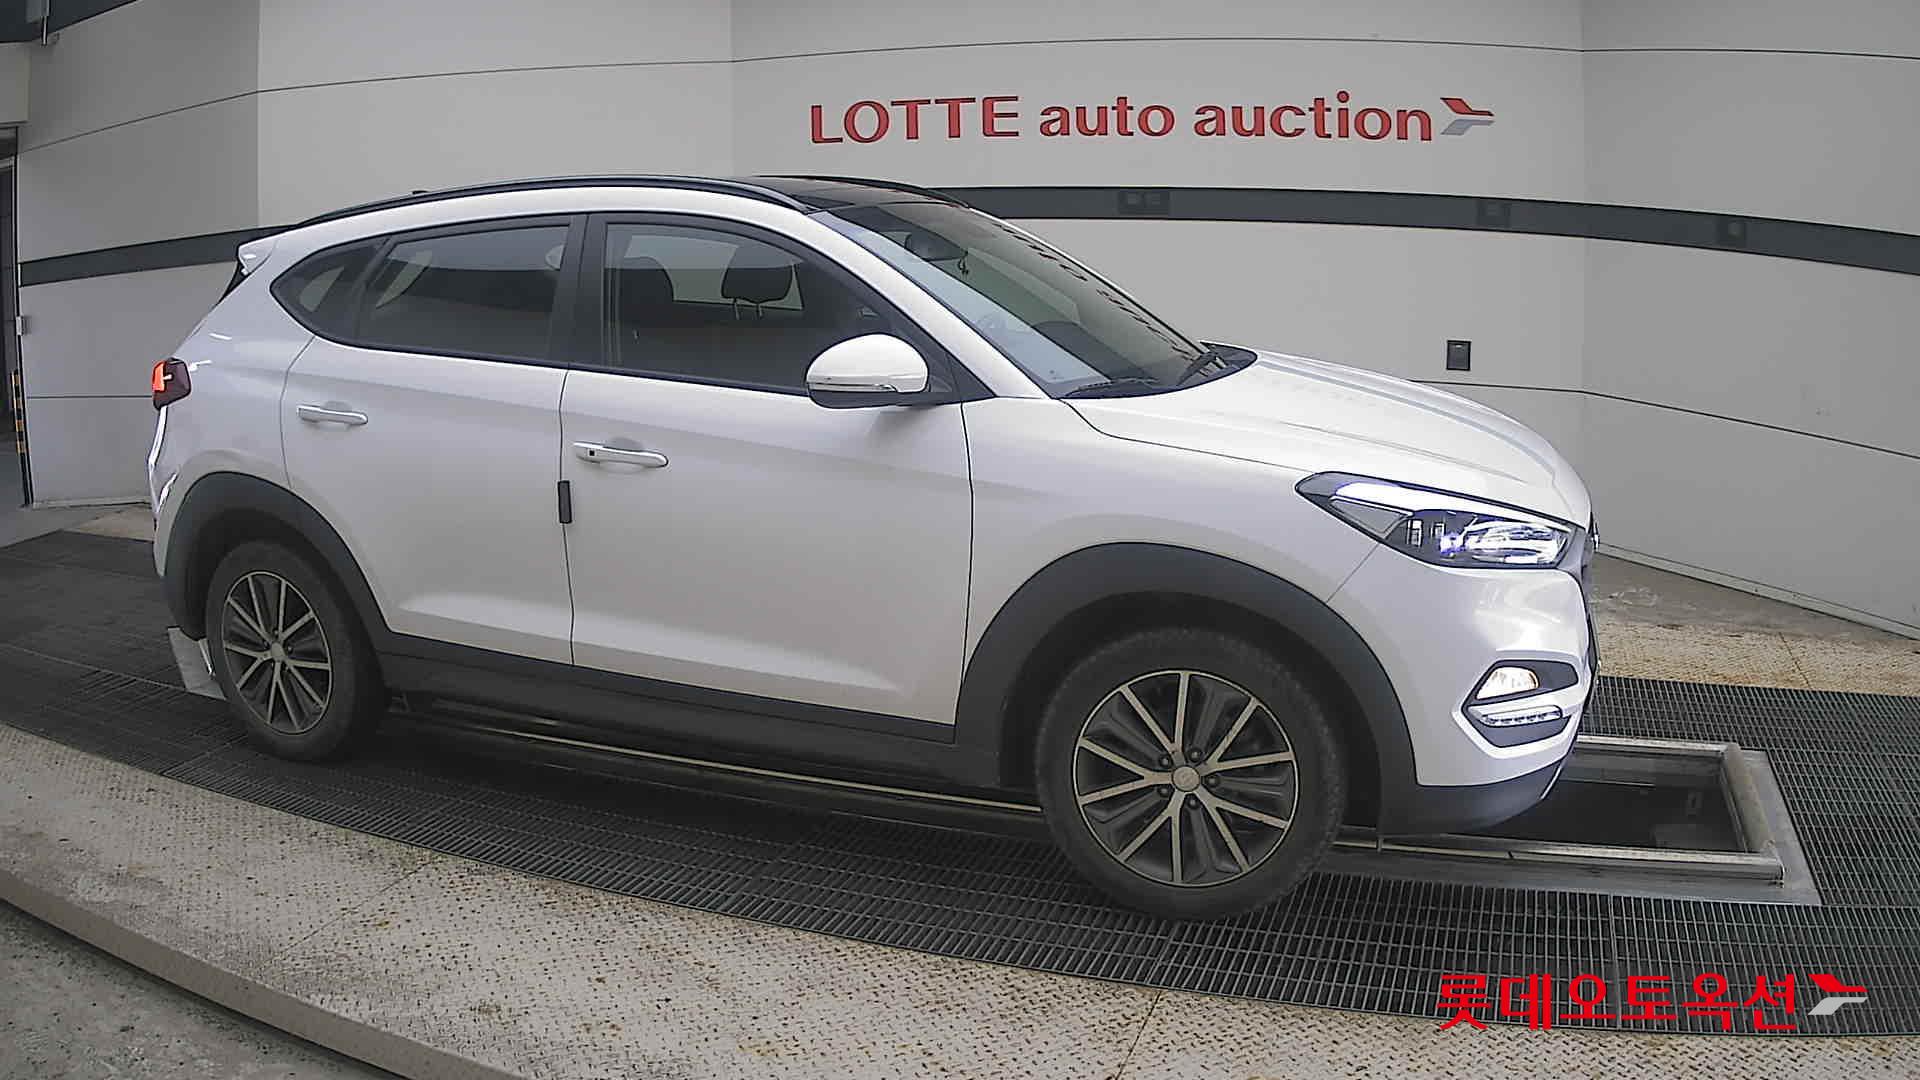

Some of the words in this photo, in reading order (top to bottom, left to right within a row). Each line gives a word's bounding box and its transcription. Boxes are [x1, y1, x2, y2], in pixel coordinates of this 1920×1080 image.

[810, 95, 1019, 144] LOTTE
[1039, 96, 1176, 137] auto
[1193, 91, 1434, 141] auction
